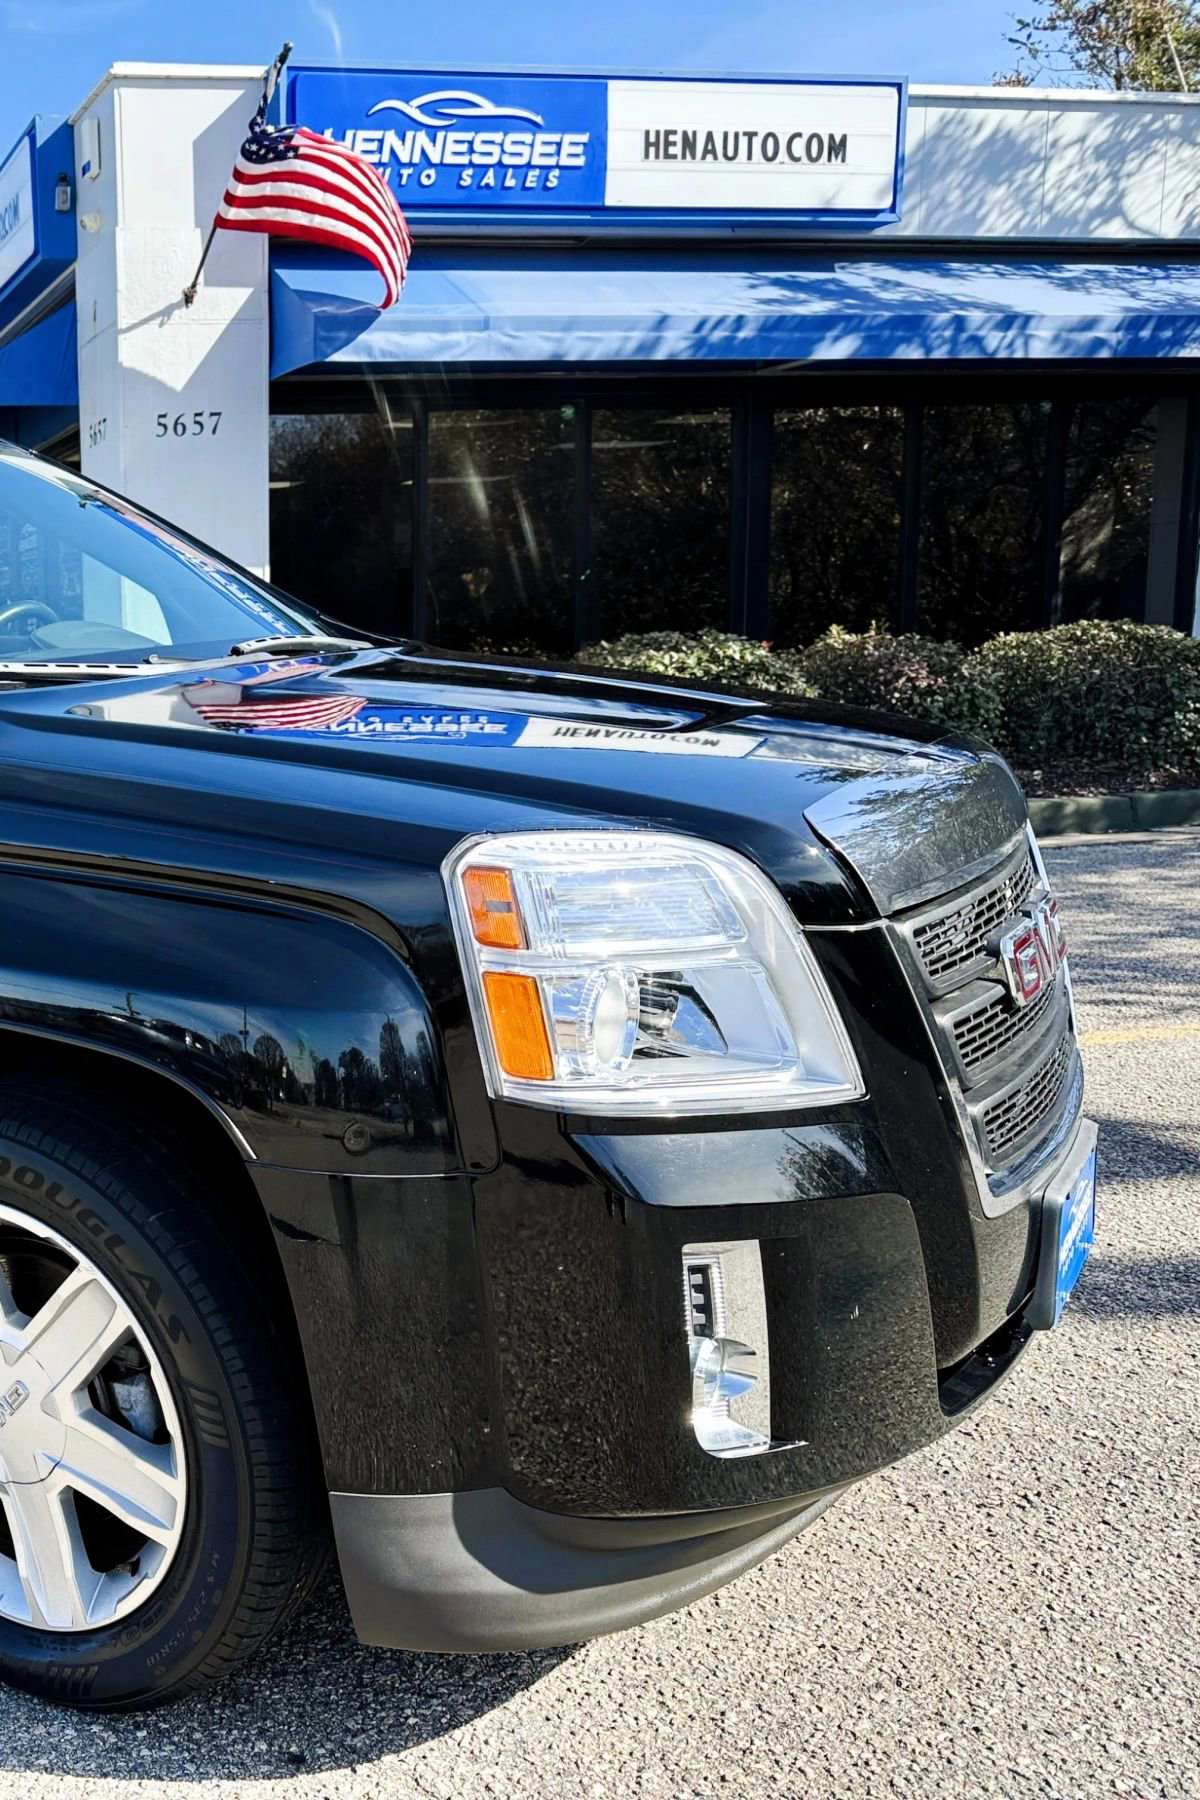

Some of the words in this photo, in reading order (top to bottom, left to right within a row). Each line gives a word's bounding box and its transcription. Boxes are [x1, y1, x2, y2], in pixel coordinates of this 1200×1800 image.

[643, 128, 848, 165] HENAUTO.COM
[458, 167, 560, 189] SALES
[155, 410, 223, 438] 5657
